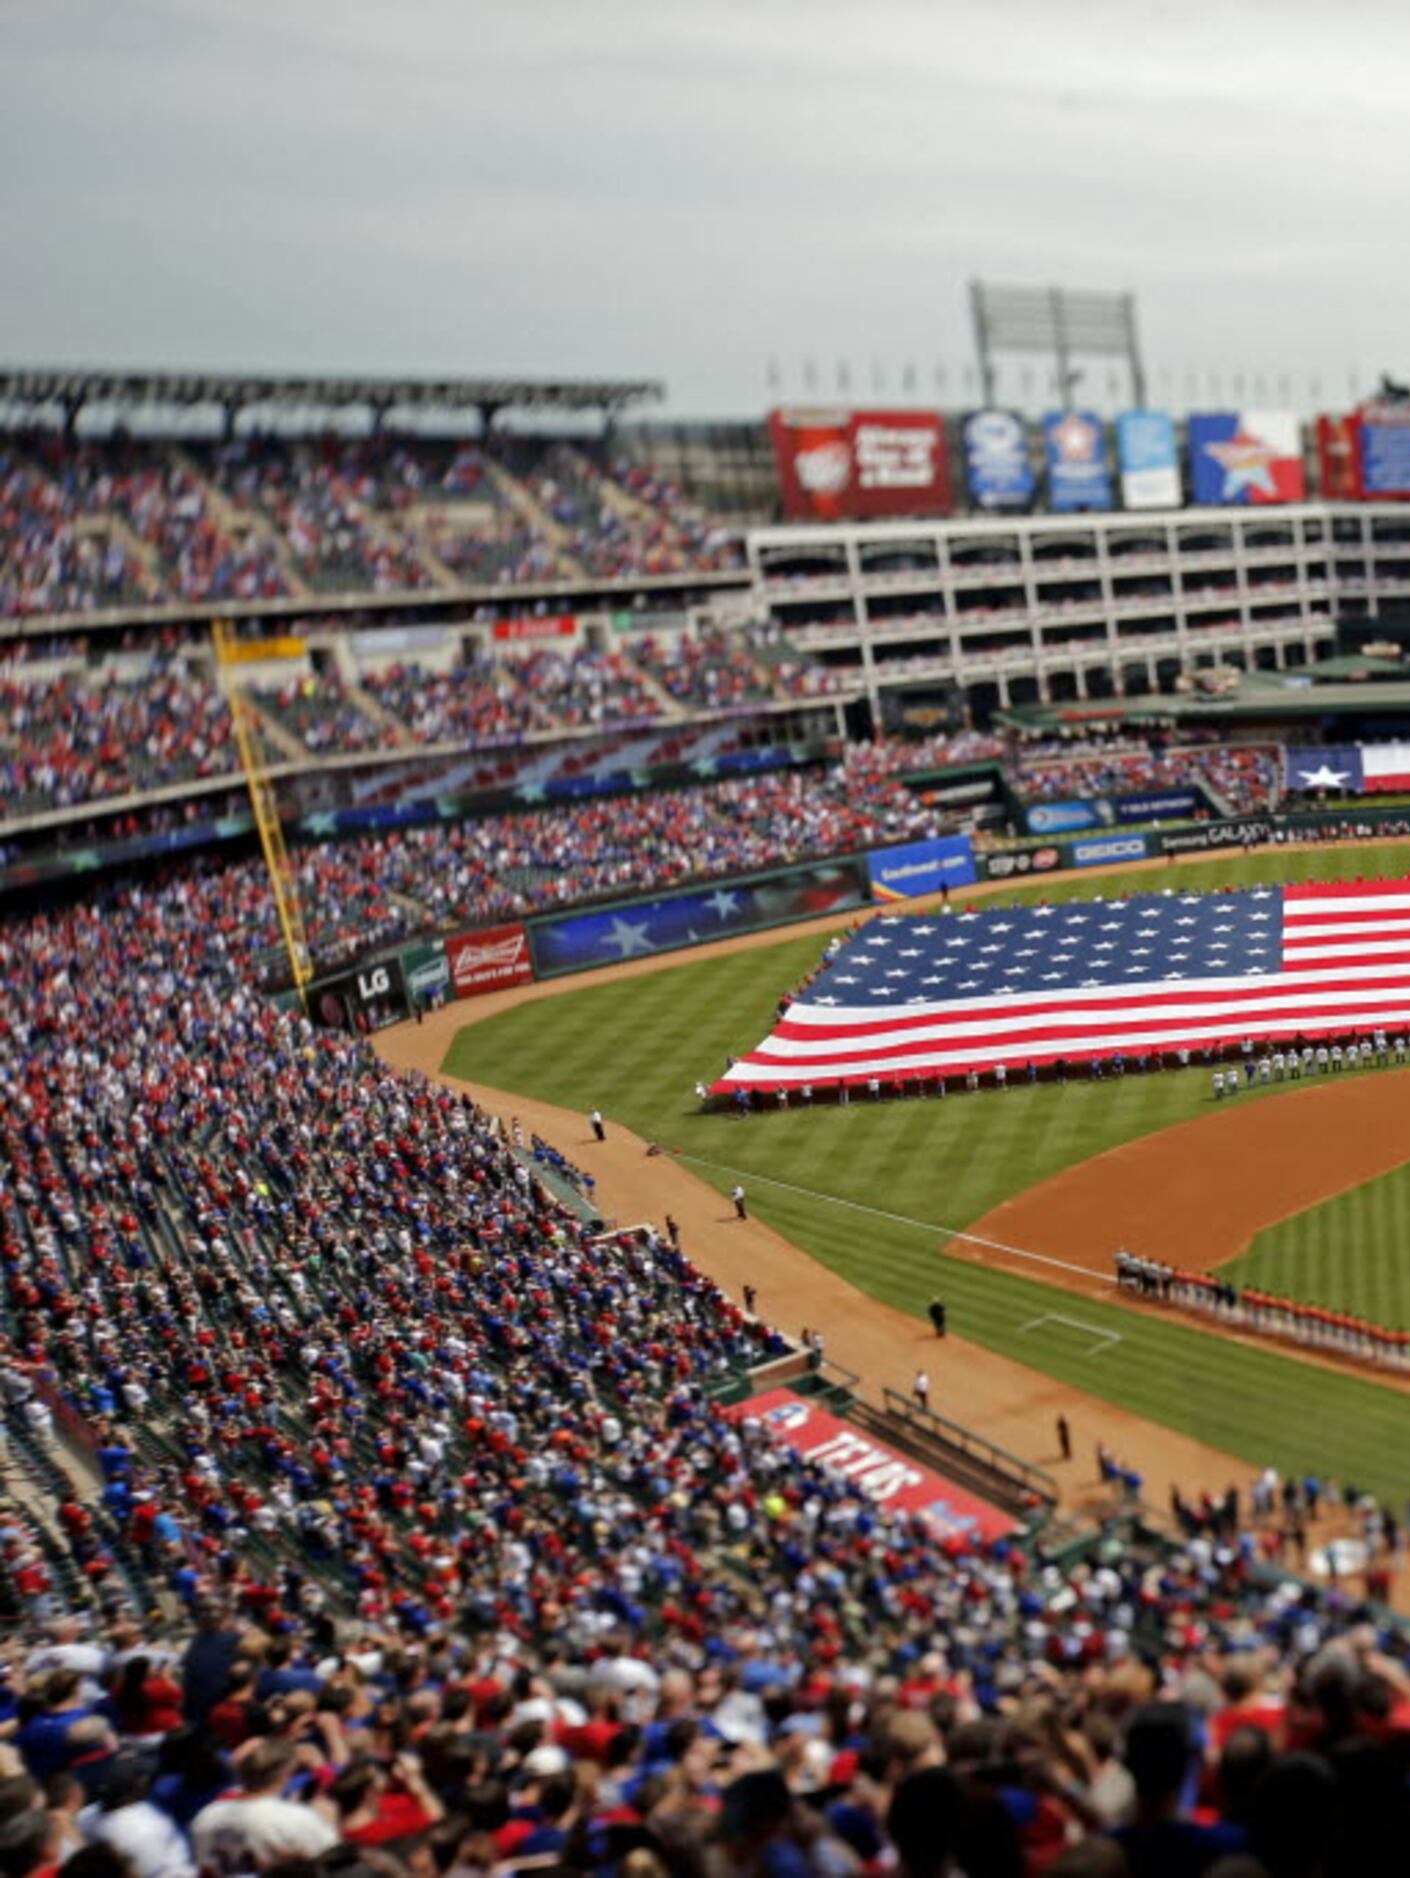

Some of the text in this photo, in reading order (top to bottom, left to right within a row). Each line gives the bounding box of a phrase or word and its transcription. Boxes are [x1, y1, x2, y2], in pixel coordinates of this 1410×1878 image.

[1074, 838, 1146, 861] GEICO
[357, 967, 391, 1000] LG
[803, 1431, 923, 1500] TEXAS
